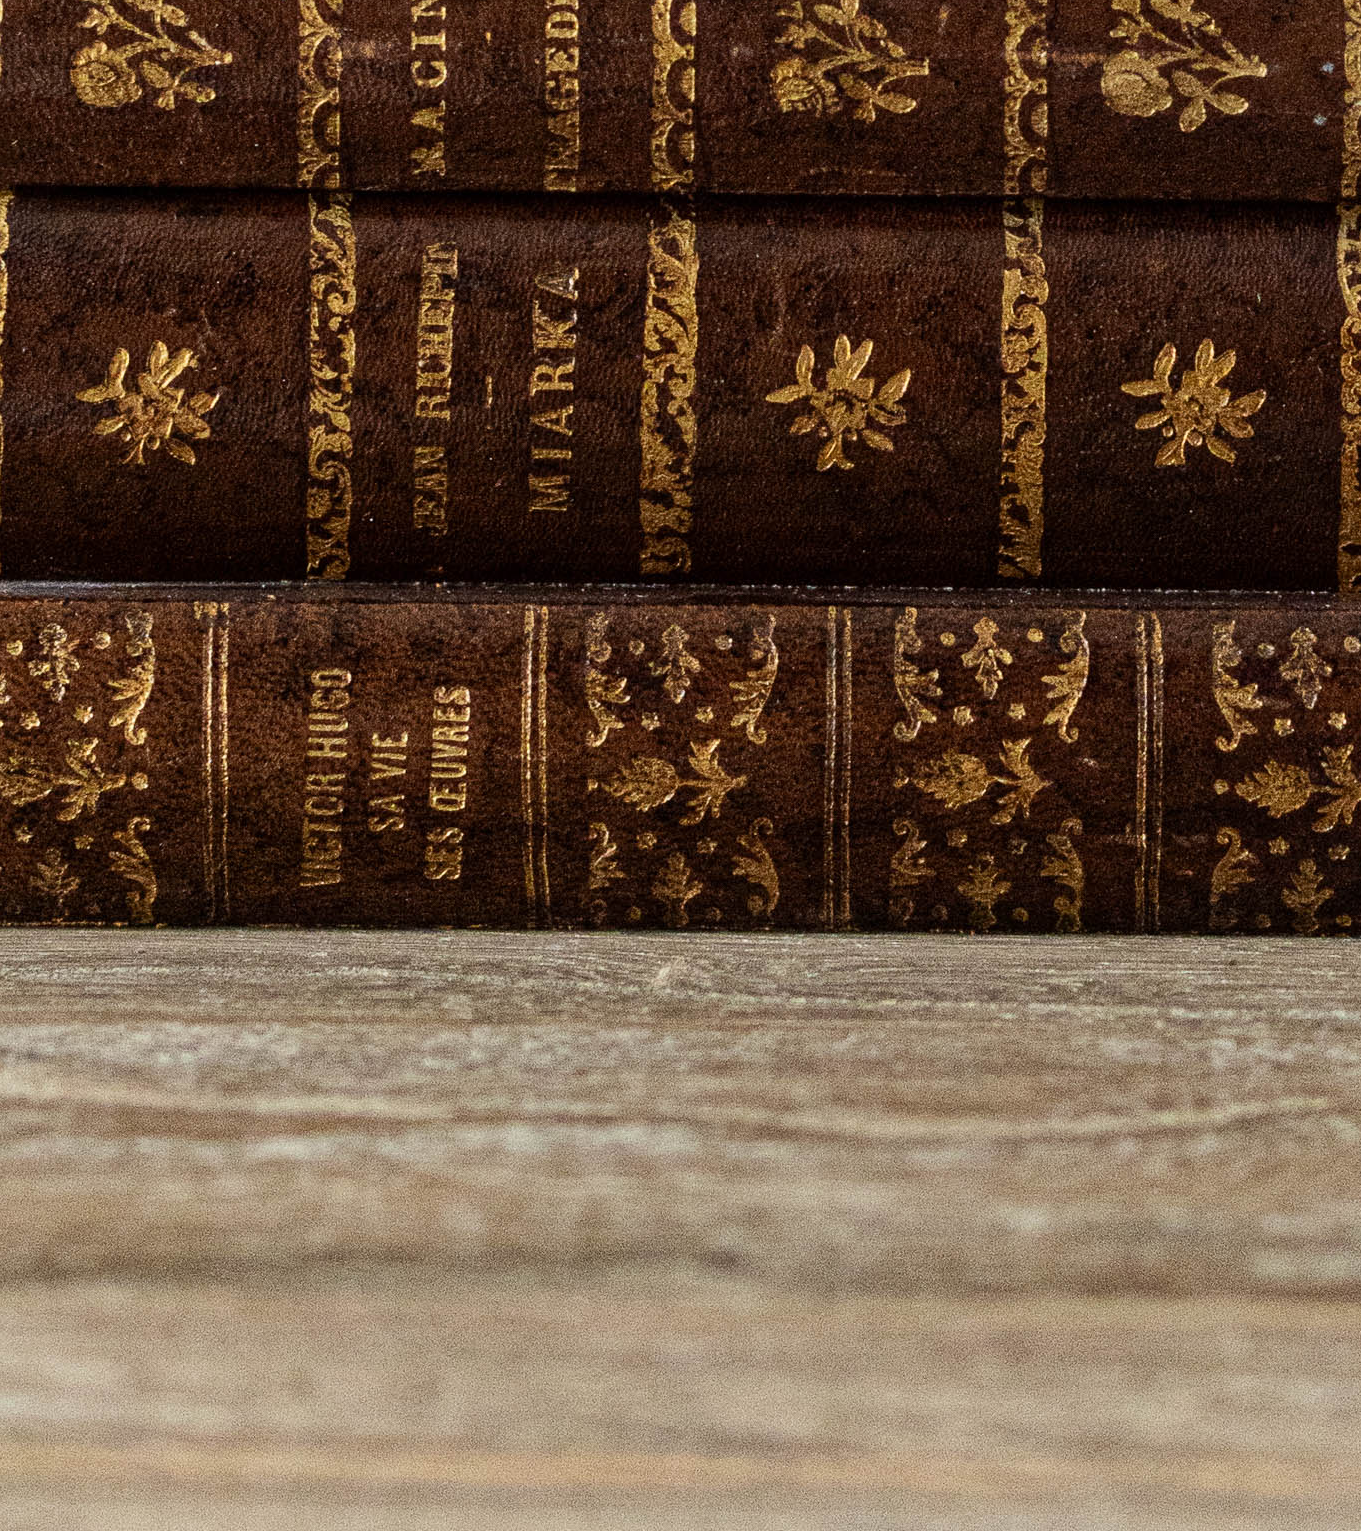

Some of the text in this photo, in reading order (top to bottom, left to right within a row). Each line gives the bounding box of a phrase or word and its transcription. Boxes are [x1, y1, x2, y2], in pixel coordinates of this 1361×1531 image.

[528, 266, 580, 512] MIARKA
[413, 445, 449, 537] JEAN
[299, 667, 353, 888] VICTOR HUGO
[368, 730, 409, 833] SA VIE
[423, 684, 471, 881] SES ŒUVRES
